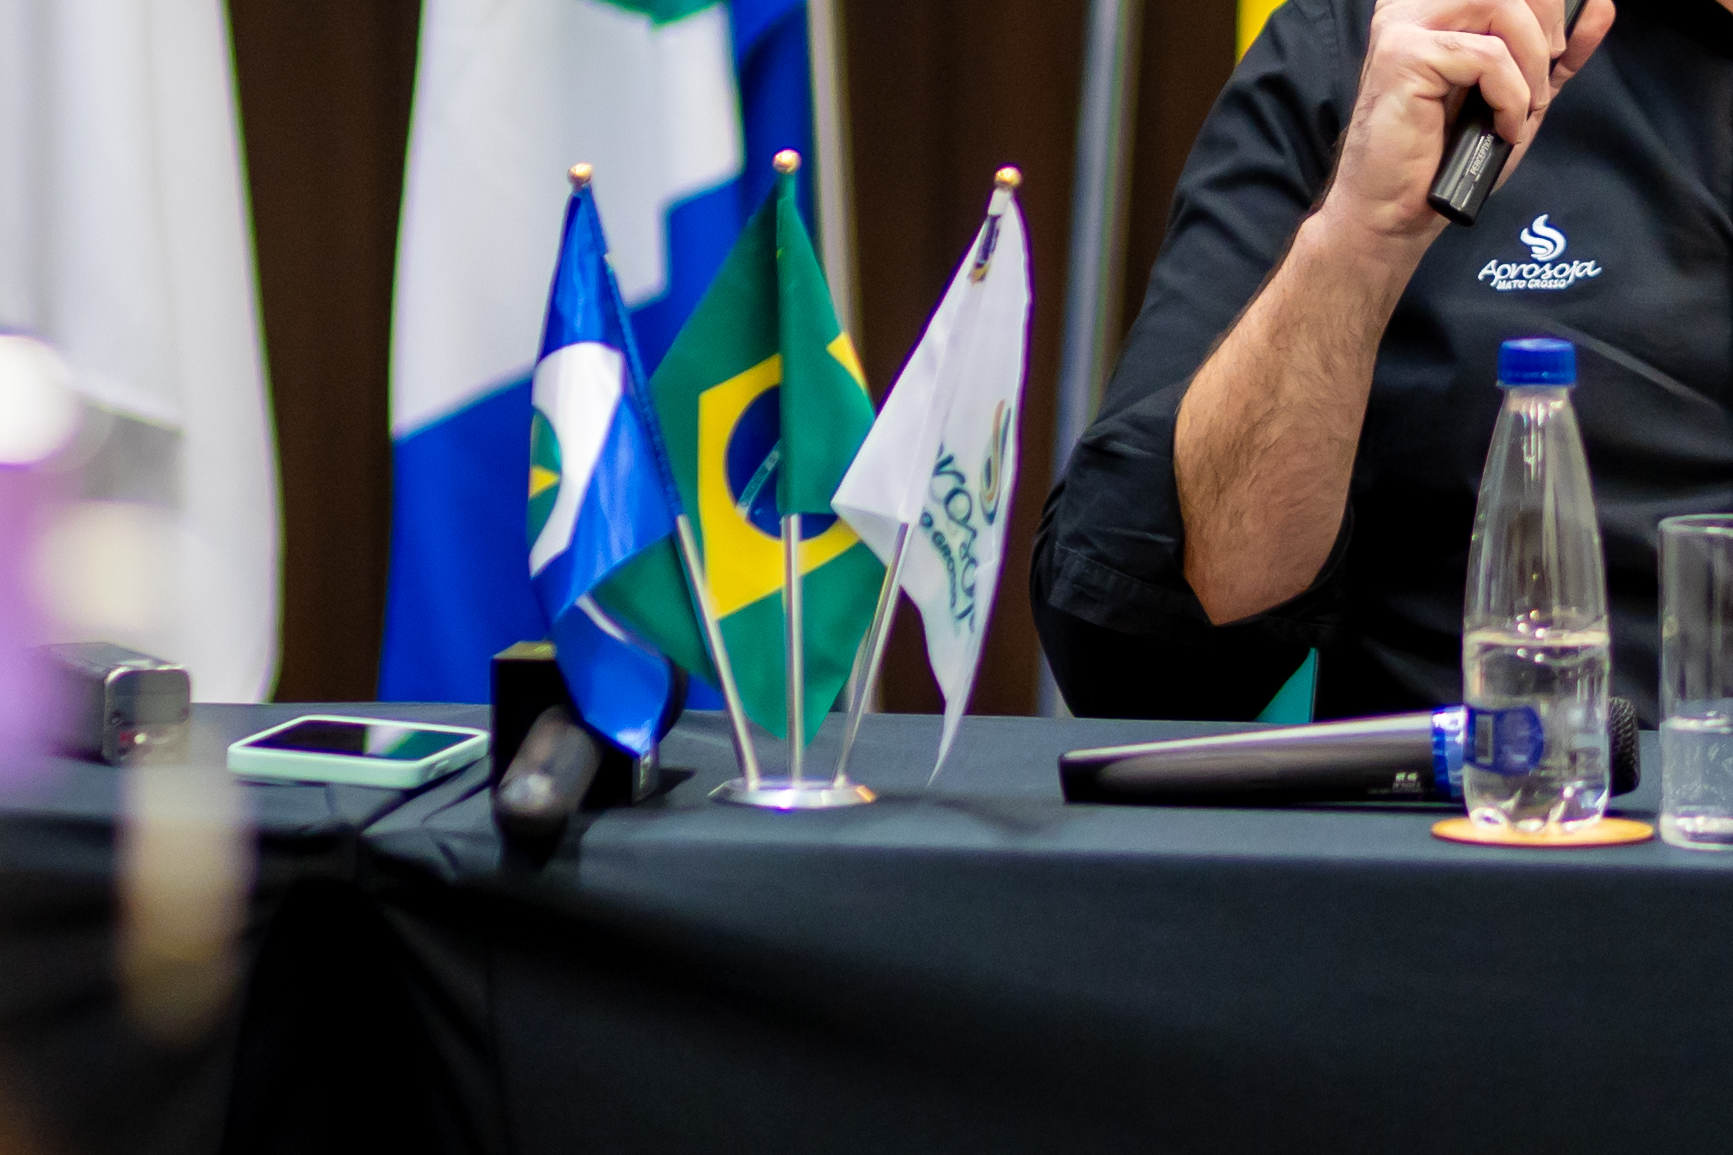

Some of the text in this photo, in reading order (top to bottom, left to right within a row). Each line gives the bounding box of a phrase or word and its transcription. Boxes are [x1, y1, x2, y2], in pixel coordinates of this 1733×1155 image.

[1478, 259, 1602, 287] Aprosoja
[1497, 278, 1566, 290] MATO GROSSO
